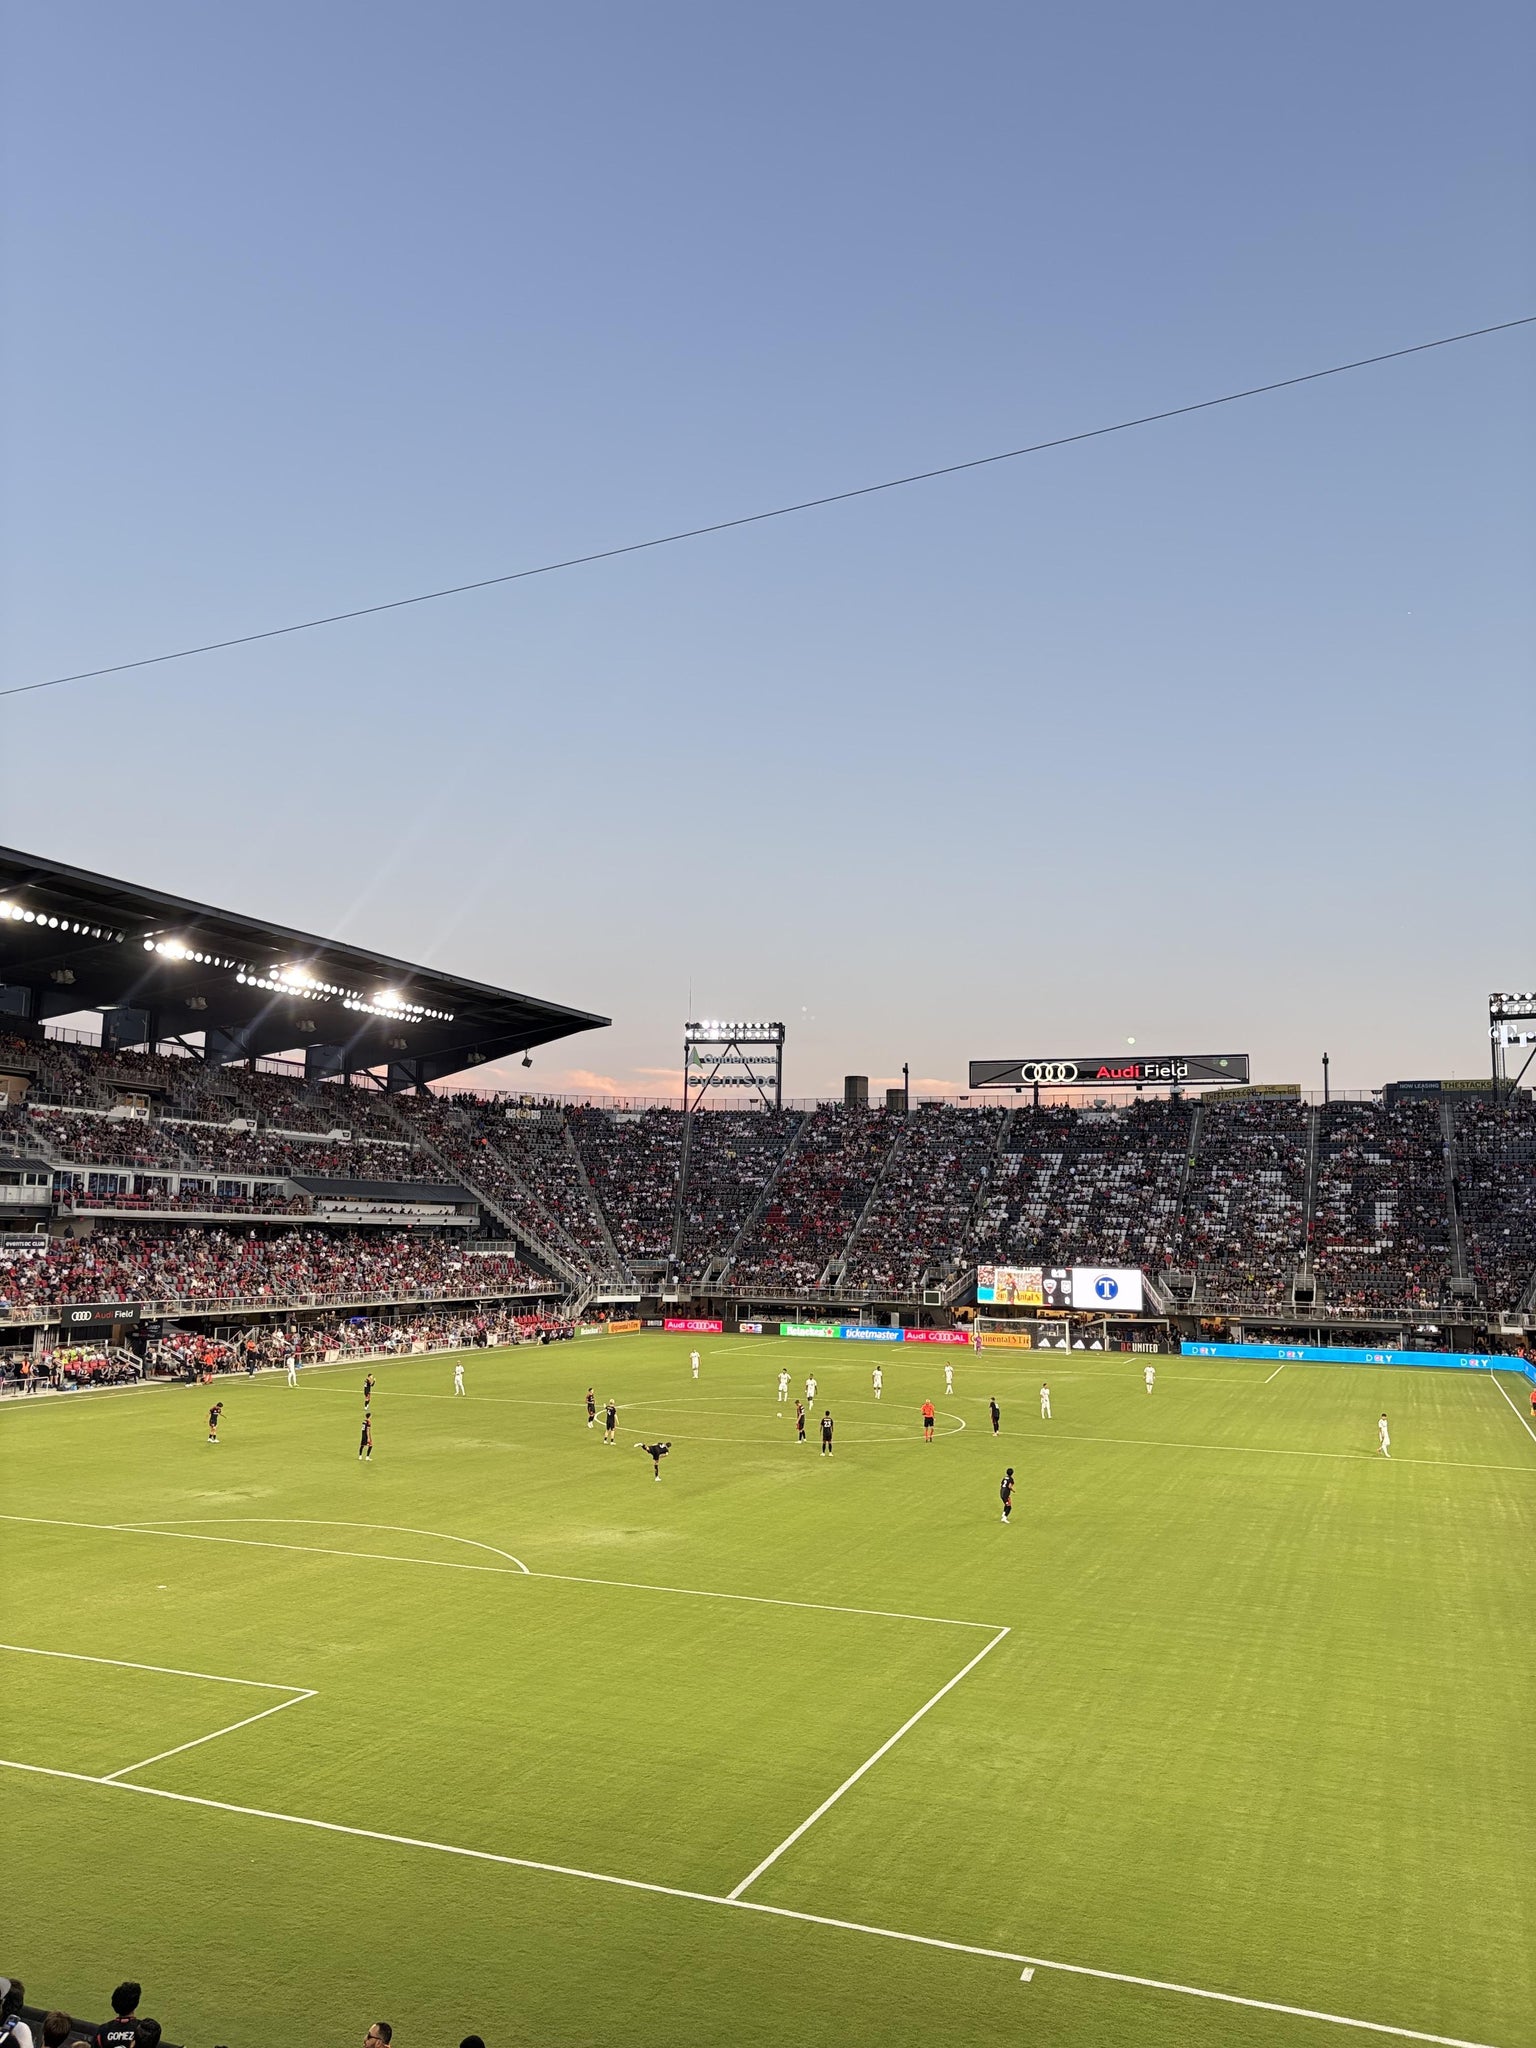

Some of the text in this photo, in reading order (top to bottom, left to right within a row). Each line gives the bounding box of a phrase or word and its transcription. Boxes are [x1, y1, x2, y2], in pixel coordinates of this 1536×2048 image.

[704, 1053, 777, 1065] Guidehouse
[1096, 1063, 1188, 1079] Audi Field
[94, 1309, 134, 1319] Audi Field
[667, 1321, 685, 1329] Audi
[786, 1325, 825, 1337] Heineken
[846, 1328, 899, 1340] ticketmaster
[906, 1331, 926, 1339] Audi
[1132, 1342, 1158, 1353] UNITED
[107, 2031, 135, 2041] GOMEZ
